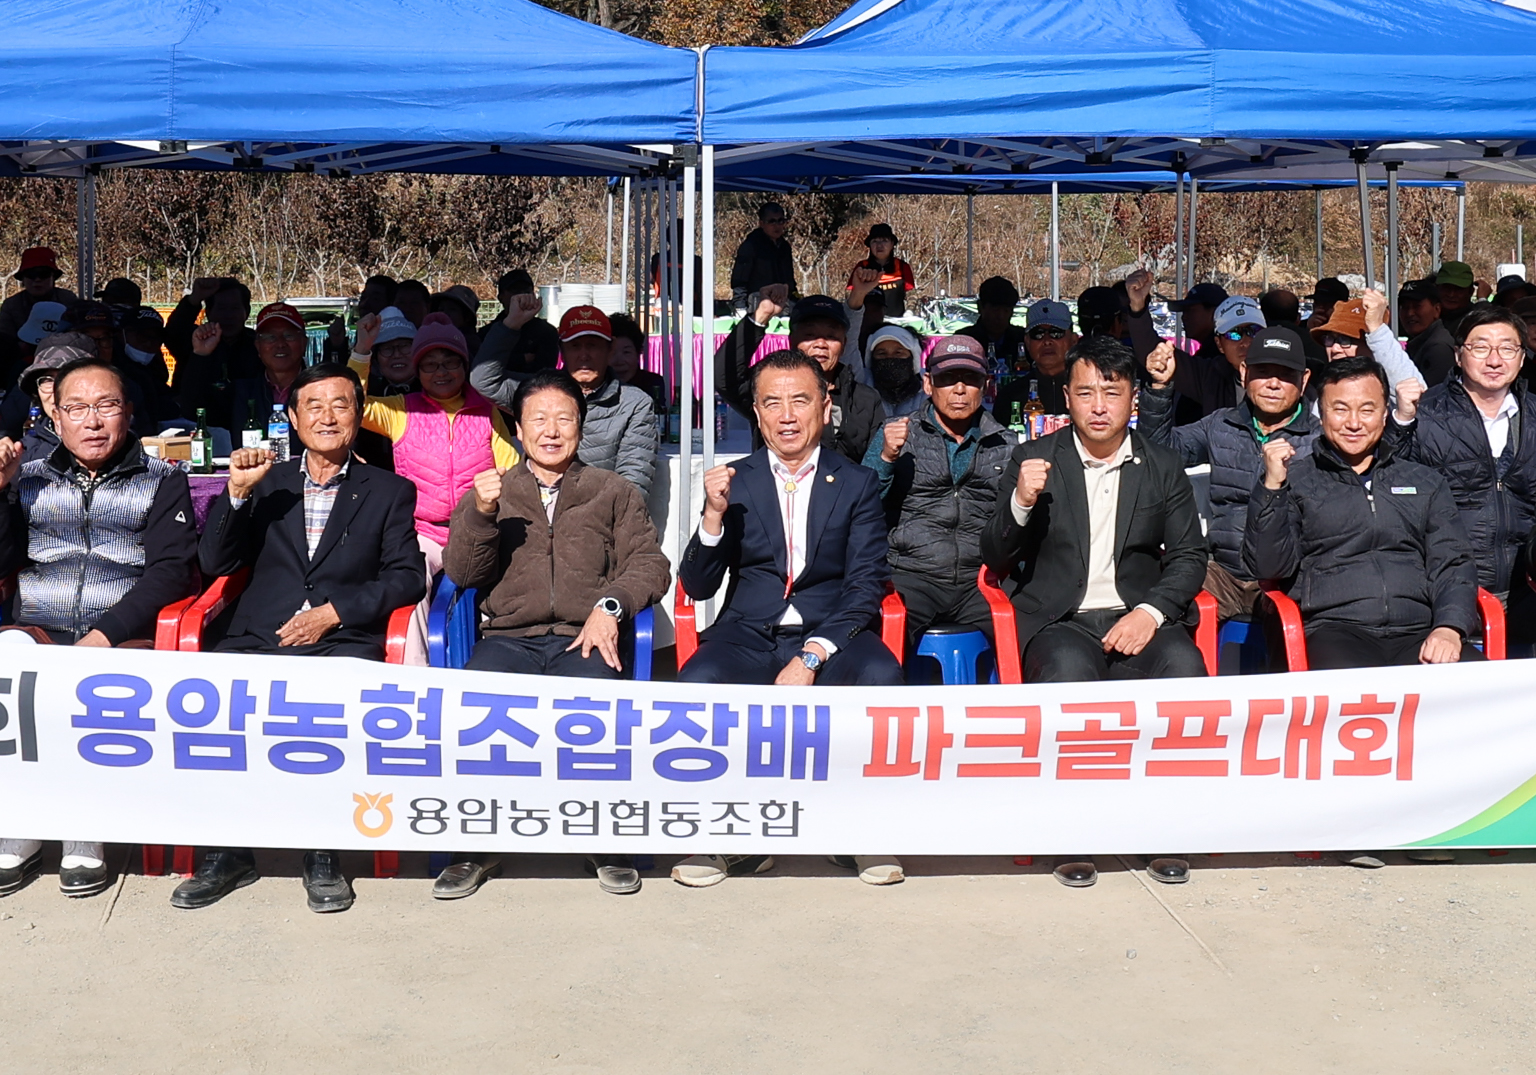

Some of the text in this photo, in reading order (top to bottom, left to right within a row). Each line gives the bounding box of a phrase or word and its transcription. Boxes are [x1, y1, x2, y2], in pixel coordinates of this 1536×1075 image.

[569, 318, 602, 328] phoenix
[70, 672, 832, 783] 용암농협조합장배
[862, 692, 1422, 782] 파크골프대회
[406, 796, 805, 840] 용암농업협동조합
